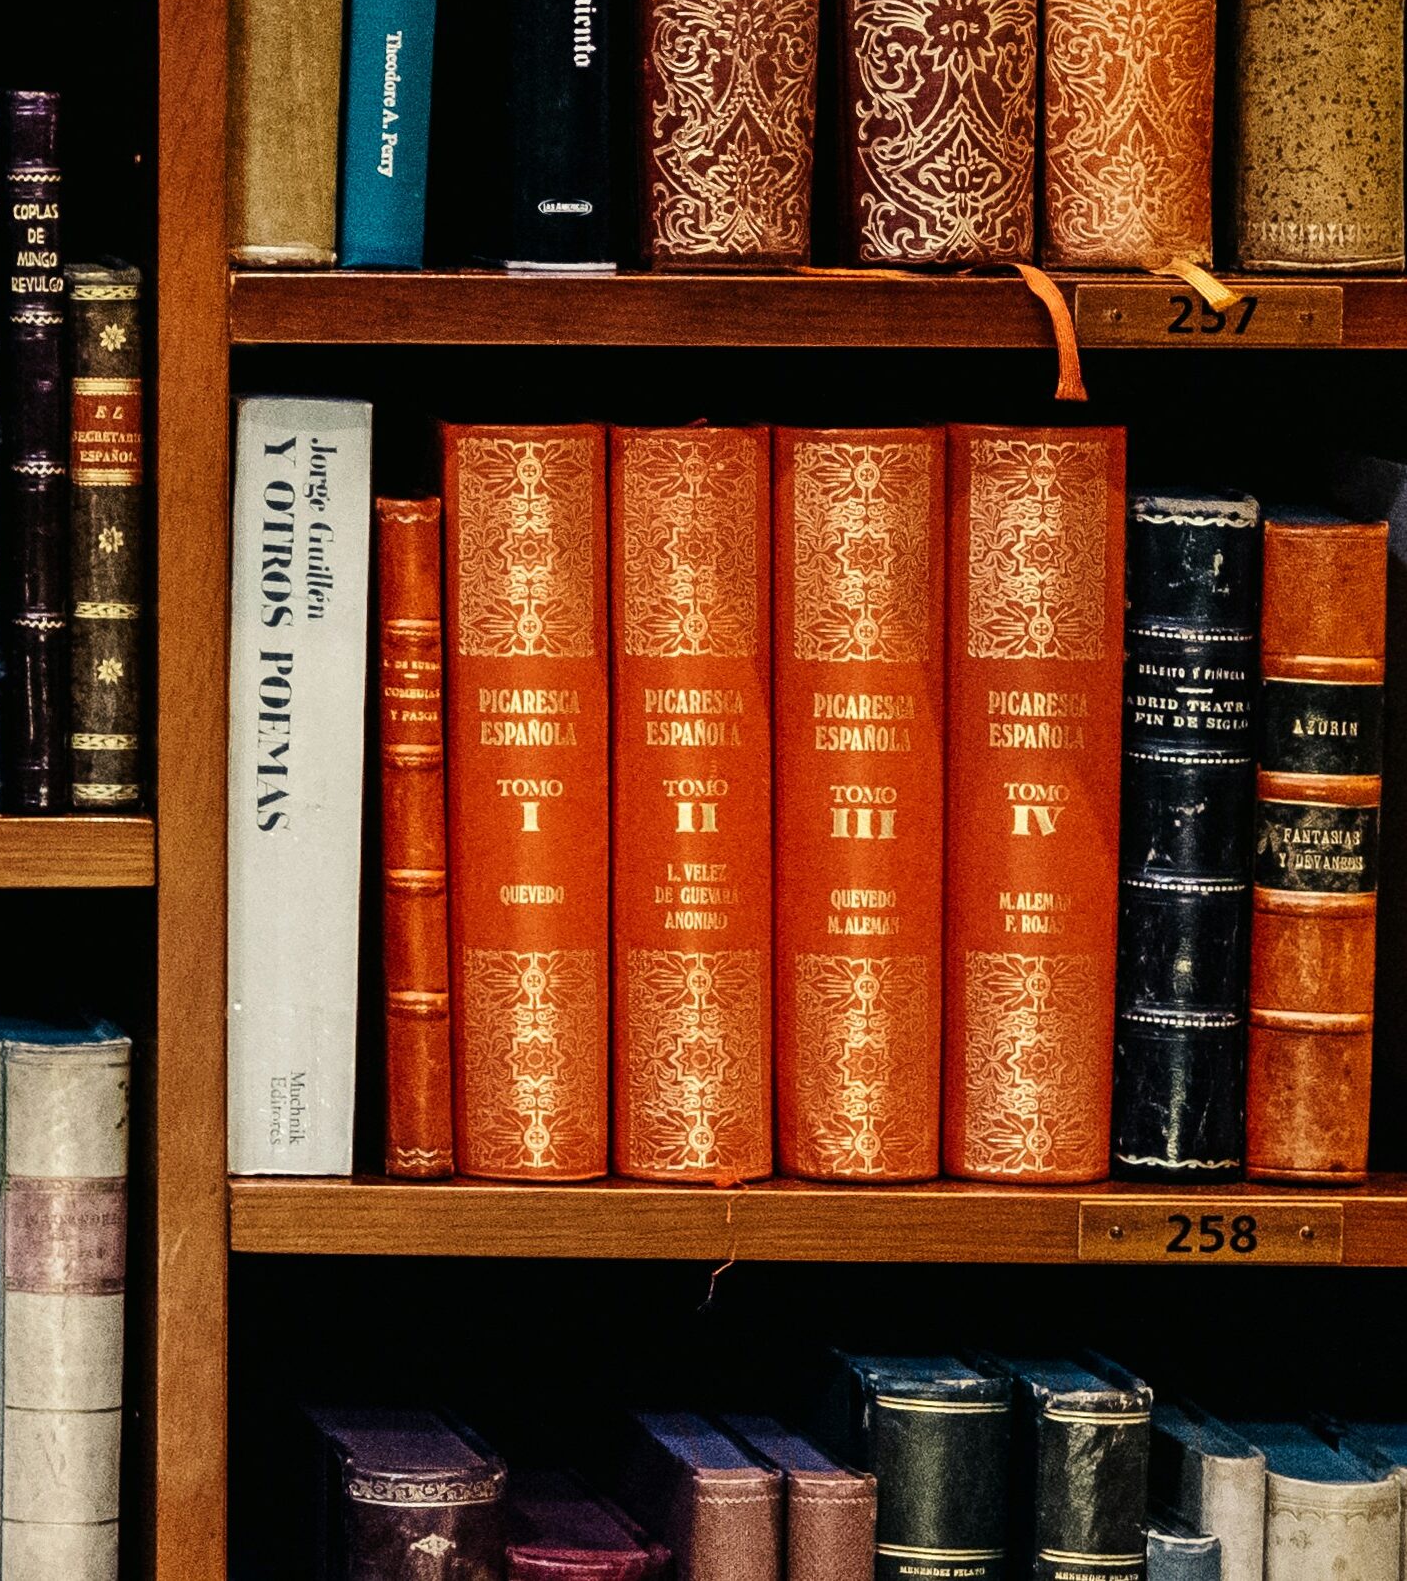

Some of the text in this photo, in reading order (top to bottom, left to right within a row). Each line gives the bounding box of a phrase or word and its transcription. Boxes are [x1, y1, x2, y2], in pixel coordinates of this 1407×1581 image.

[13, 202, 60, 221] COPLAS
[27, 227, 46, 245] DE
[16, 250, 58, 268] MINGO
[302, 437, 337, 620] Jorge Guillén
[255, 436, 298, 833] Y OTROS POEMAS
[478, 688, 581, 714] PICARESCA
[813, 692, 916, 719] PICARESCA
[479, 720, 577, 746] ESPAÑOLA
[496, 778, 564, 797] TOMO
[663, 778, 728, 797] TOMO
[829, 785, 898, 805] TOMO
[1004, 783, 1070, 803] TOMO
[520, 801, 541, 832] I
[675, 801, 719, 833] II
[829, 807, 898, 840] III
[1011, 805, 1065, 838] IV
[499, 885, 565, 905] QUEVEDO
[270, 1076, 287, 1146] Editores
[288, 1071, 307, 1145] Muchnik
[1167, 1215, 1258, 1253] 258
